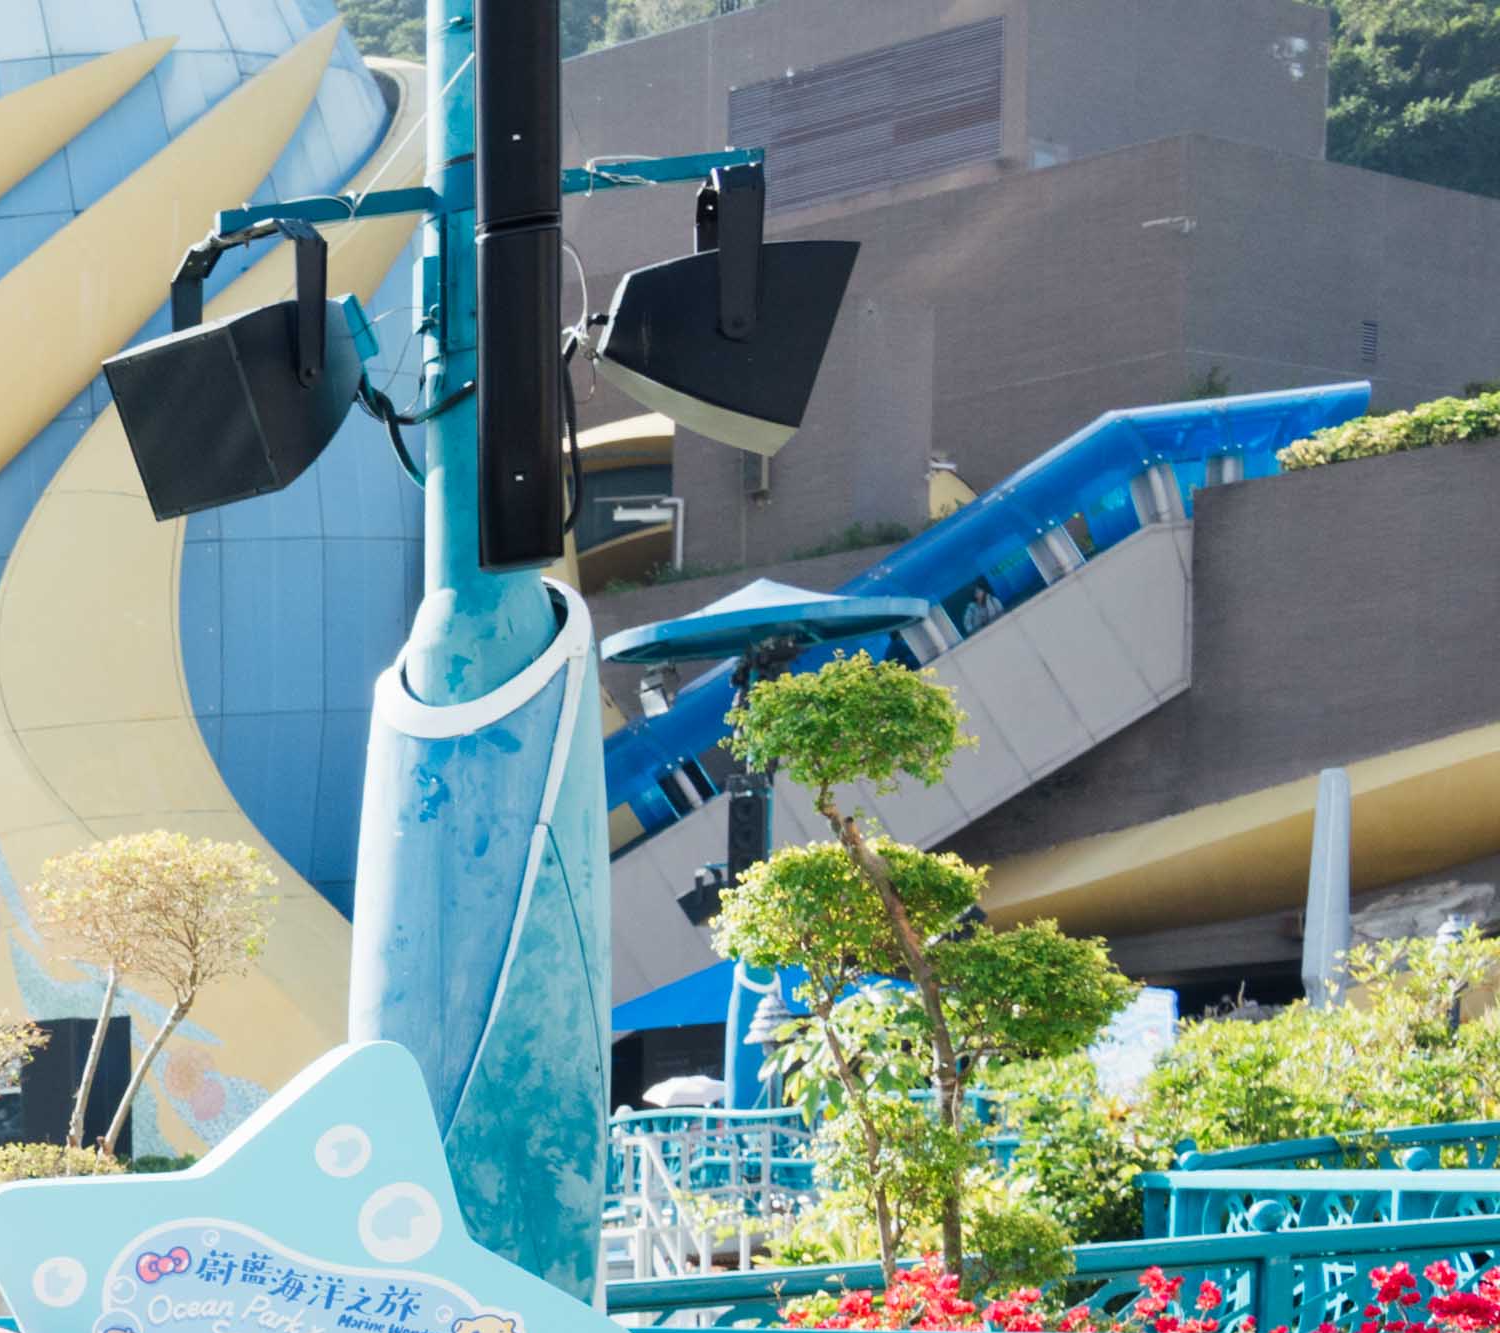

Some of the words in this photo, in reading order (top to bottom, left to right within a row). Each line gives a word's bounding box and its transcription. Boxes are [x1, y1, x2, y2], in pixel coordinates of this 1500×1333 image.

[148, 1295, 235, 1324] Ocean
[196, 1249, 421, 1322] 蔚藍海洋之旅
